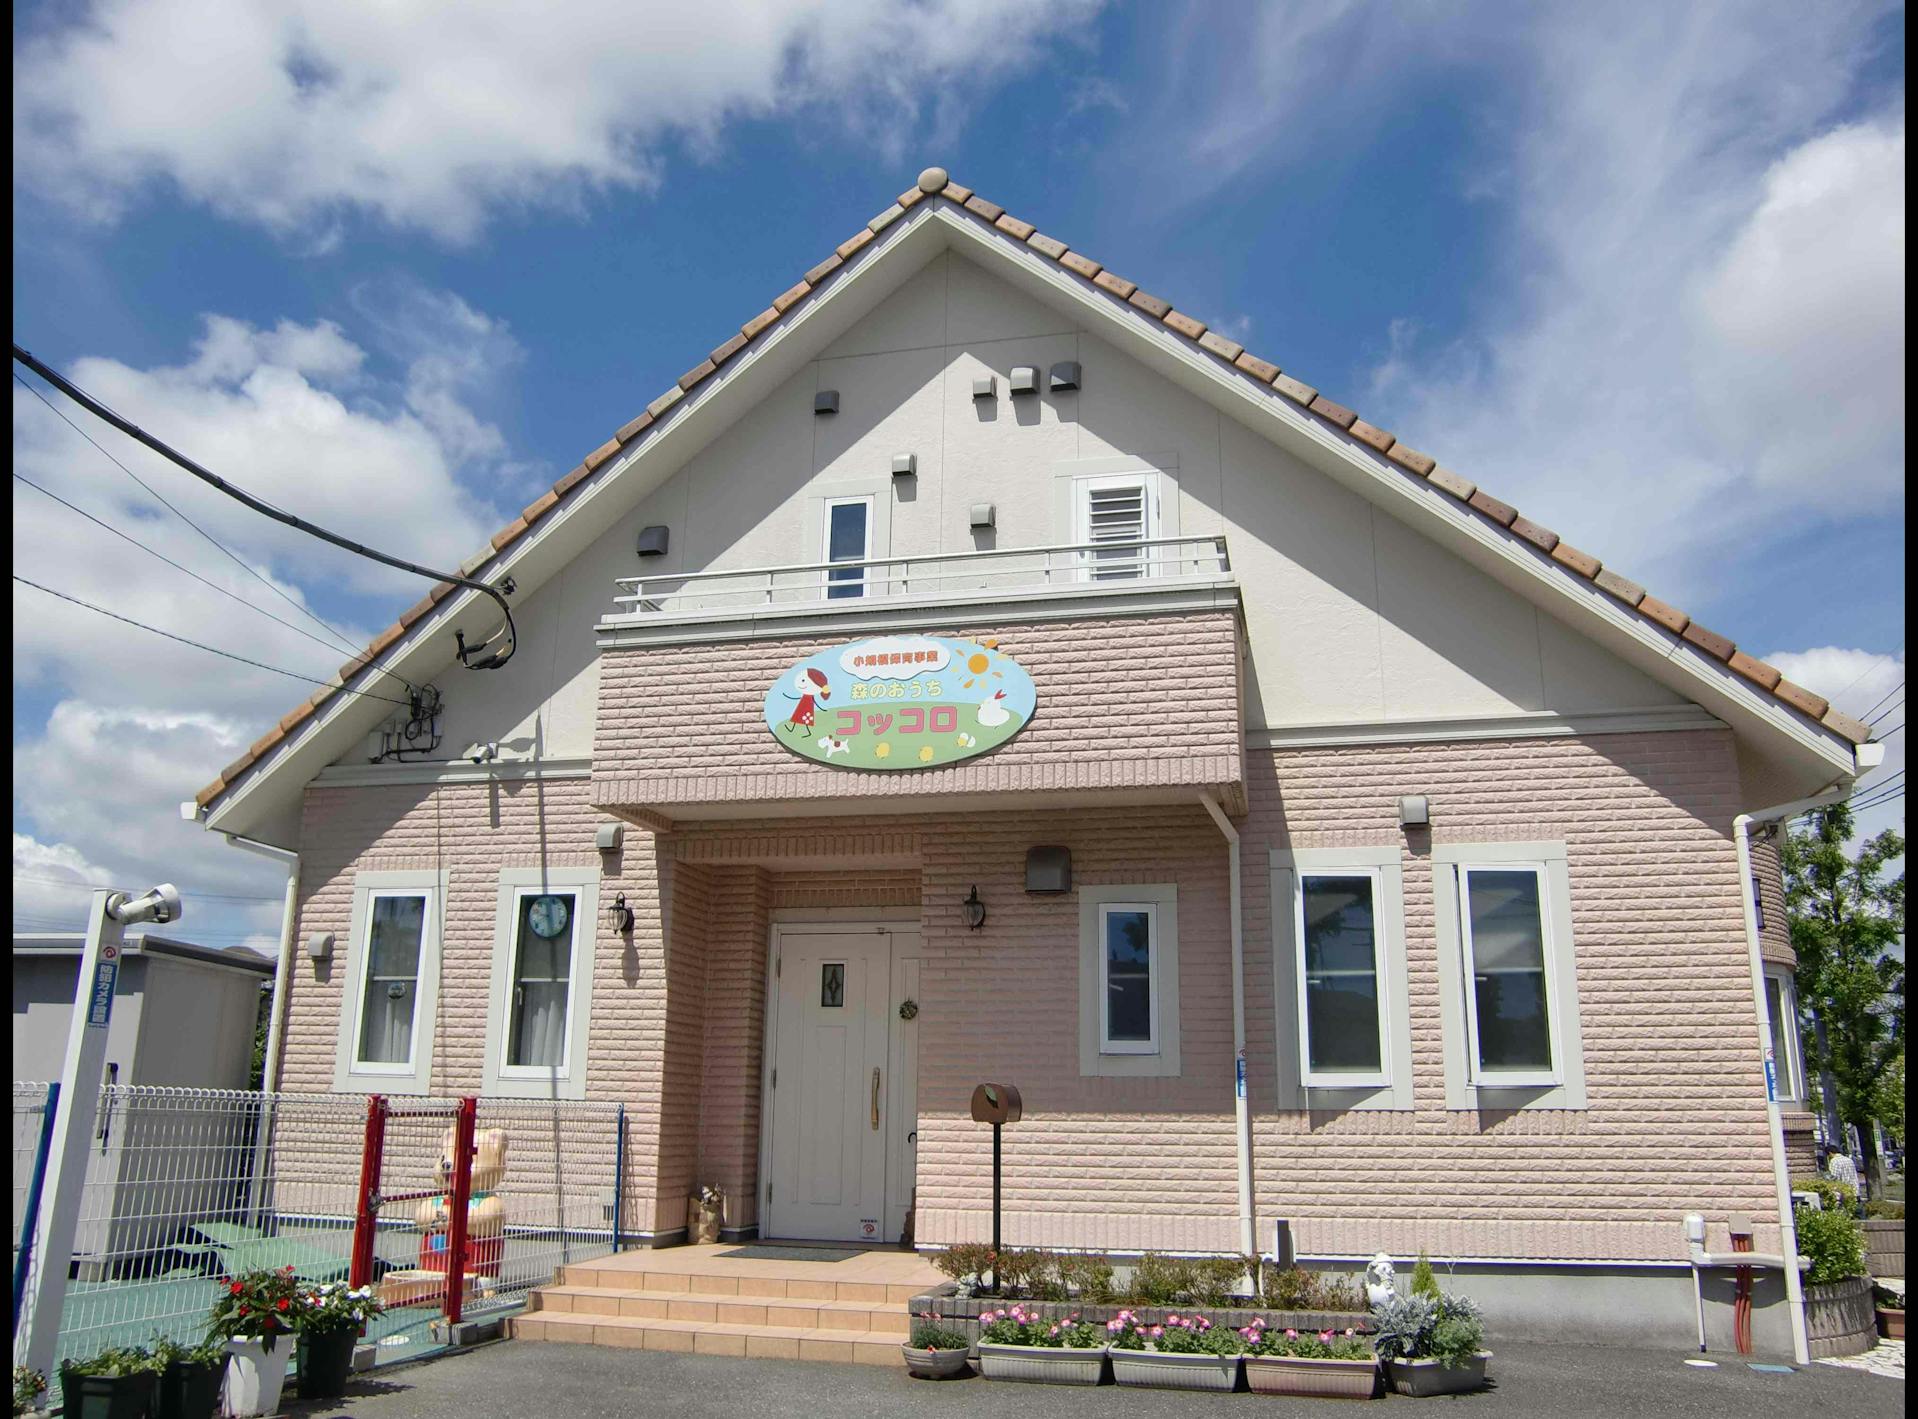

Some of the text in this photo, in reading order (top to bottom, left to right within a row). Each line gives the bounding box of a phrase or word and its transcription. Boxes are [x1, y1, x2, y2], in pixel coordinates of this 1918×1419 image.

[851, 680, 944, 699] 森のおうち
[836, 706, 957, 735] コッコロ
